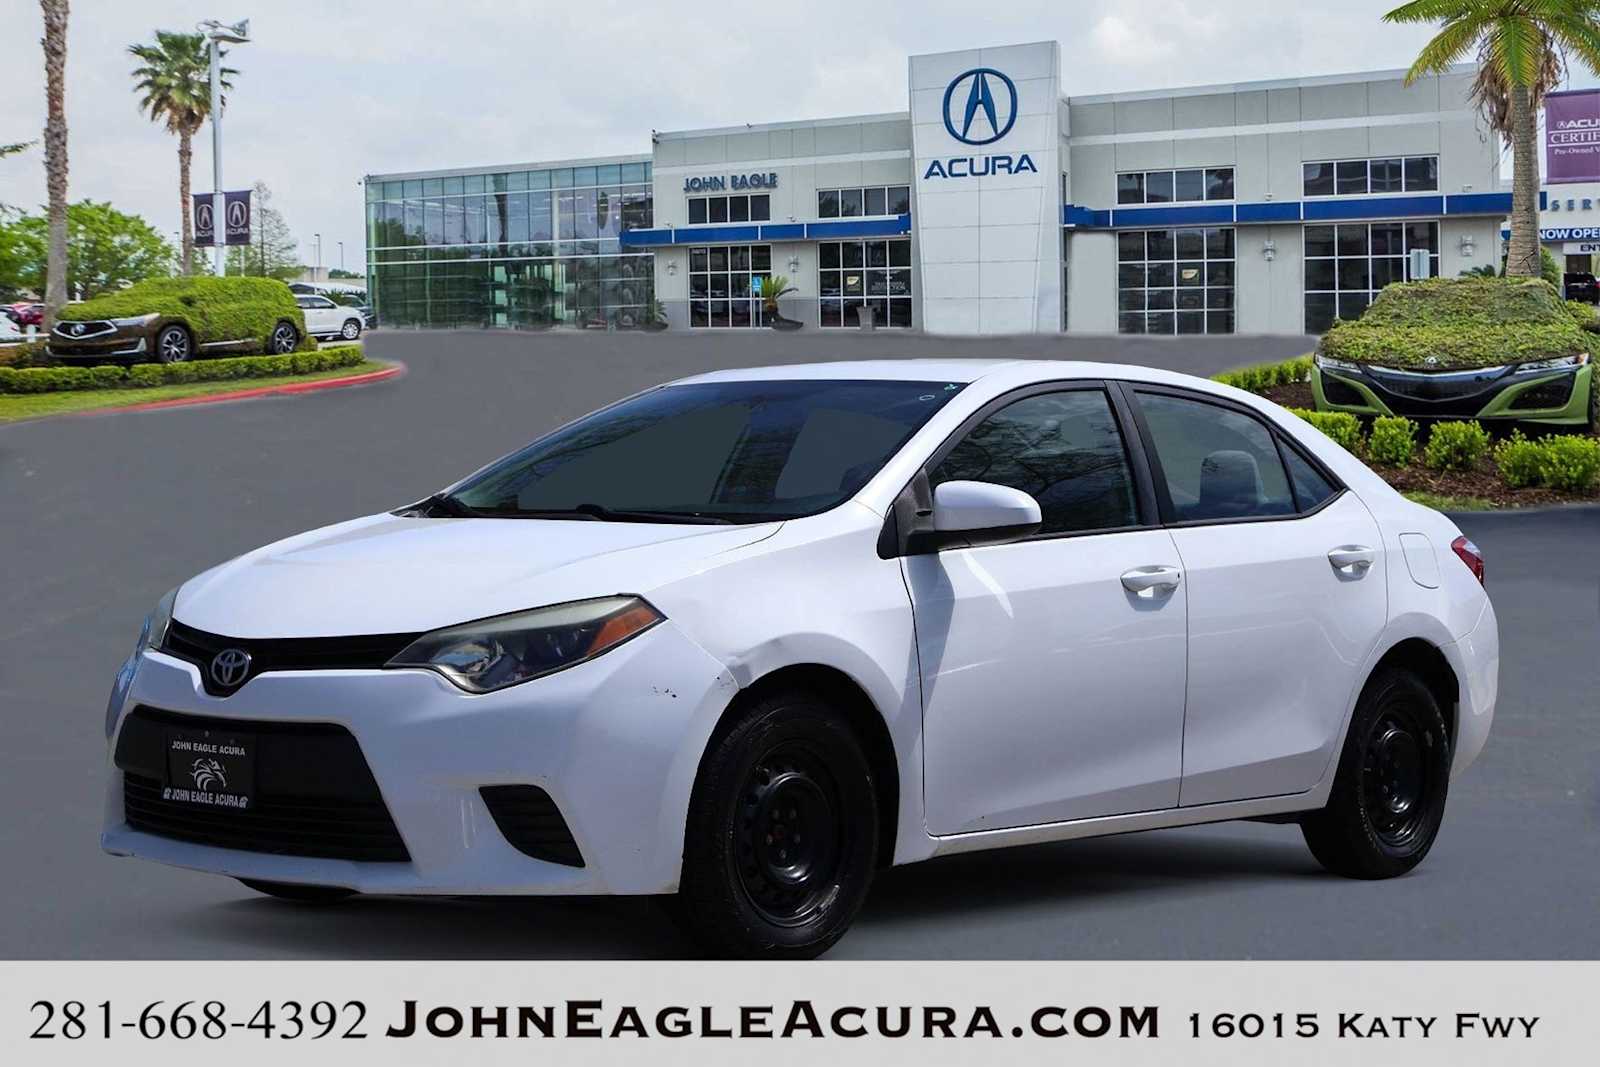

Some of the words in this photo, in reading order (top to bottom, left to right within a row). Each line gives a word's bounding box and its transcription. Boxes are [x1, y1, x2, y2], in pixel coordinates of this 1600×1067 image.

[1567, 119, 1600, 128] ACU
[924, 154, 1038, 180] ACURA
[683, 176, 726, 192] JOHN
[731, 173, 778, 190] EAGLE
[1540, 229, 1570, 240] NOW
[1572, 227, 1600, 239] OPE
[172, 740, 191, 750] JOHN
[193, 743, 217, 753] EAGLE
[219, 746, 246, 756] ACURA
[172, 788, 190, 802] JOHN
[191, 791, 213, 804] EAGLE
[215, 793, 239, 807] ACURA
